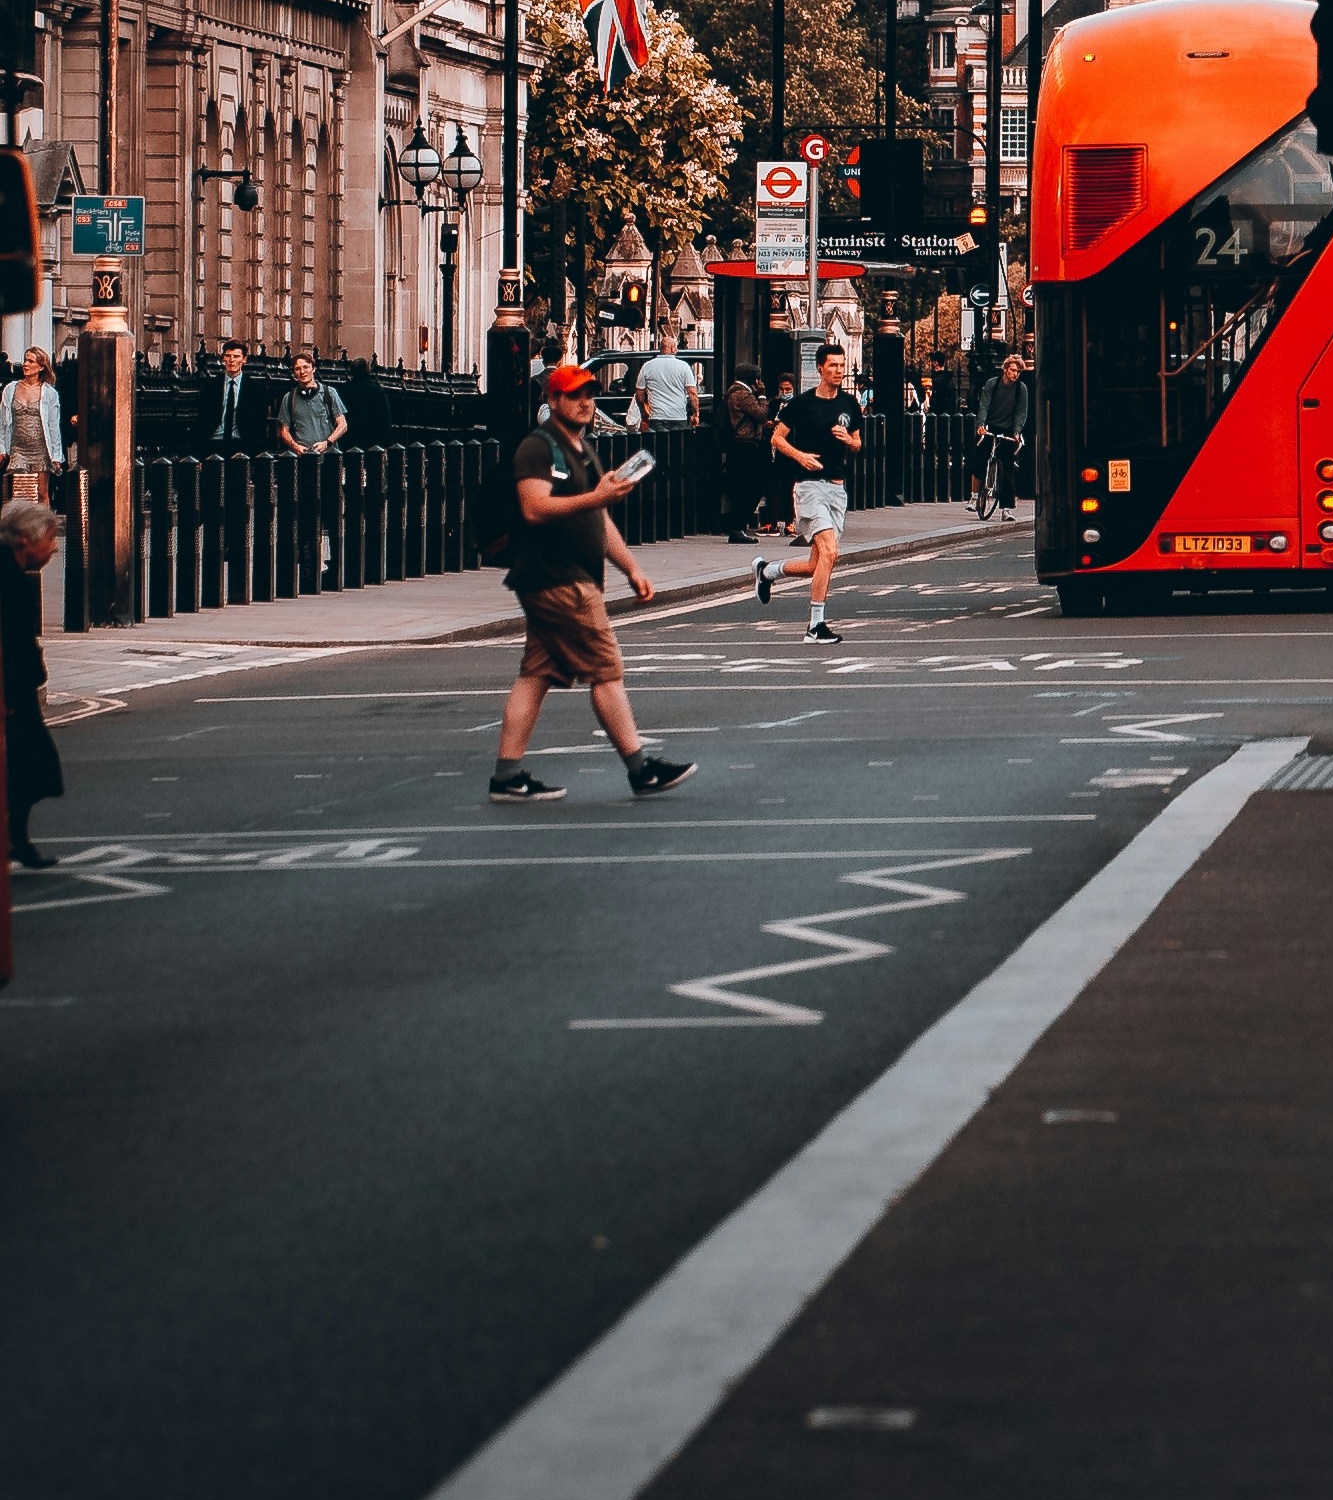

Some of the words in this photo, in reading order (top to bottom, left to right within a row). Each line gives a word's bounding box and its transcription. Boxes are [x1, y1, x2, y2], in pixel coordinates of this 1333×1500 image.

[805, 139, 824, 160] G
[901, 234, 958, 247] Station
[1195, 227, 1249, 265] 24
[825, 248, 862, 258] Subway
[914, 248, 947, 256] Toilets
[1182, 537, 1209, 551] LTZ
[1212, 537, 1243, 551] 1033
